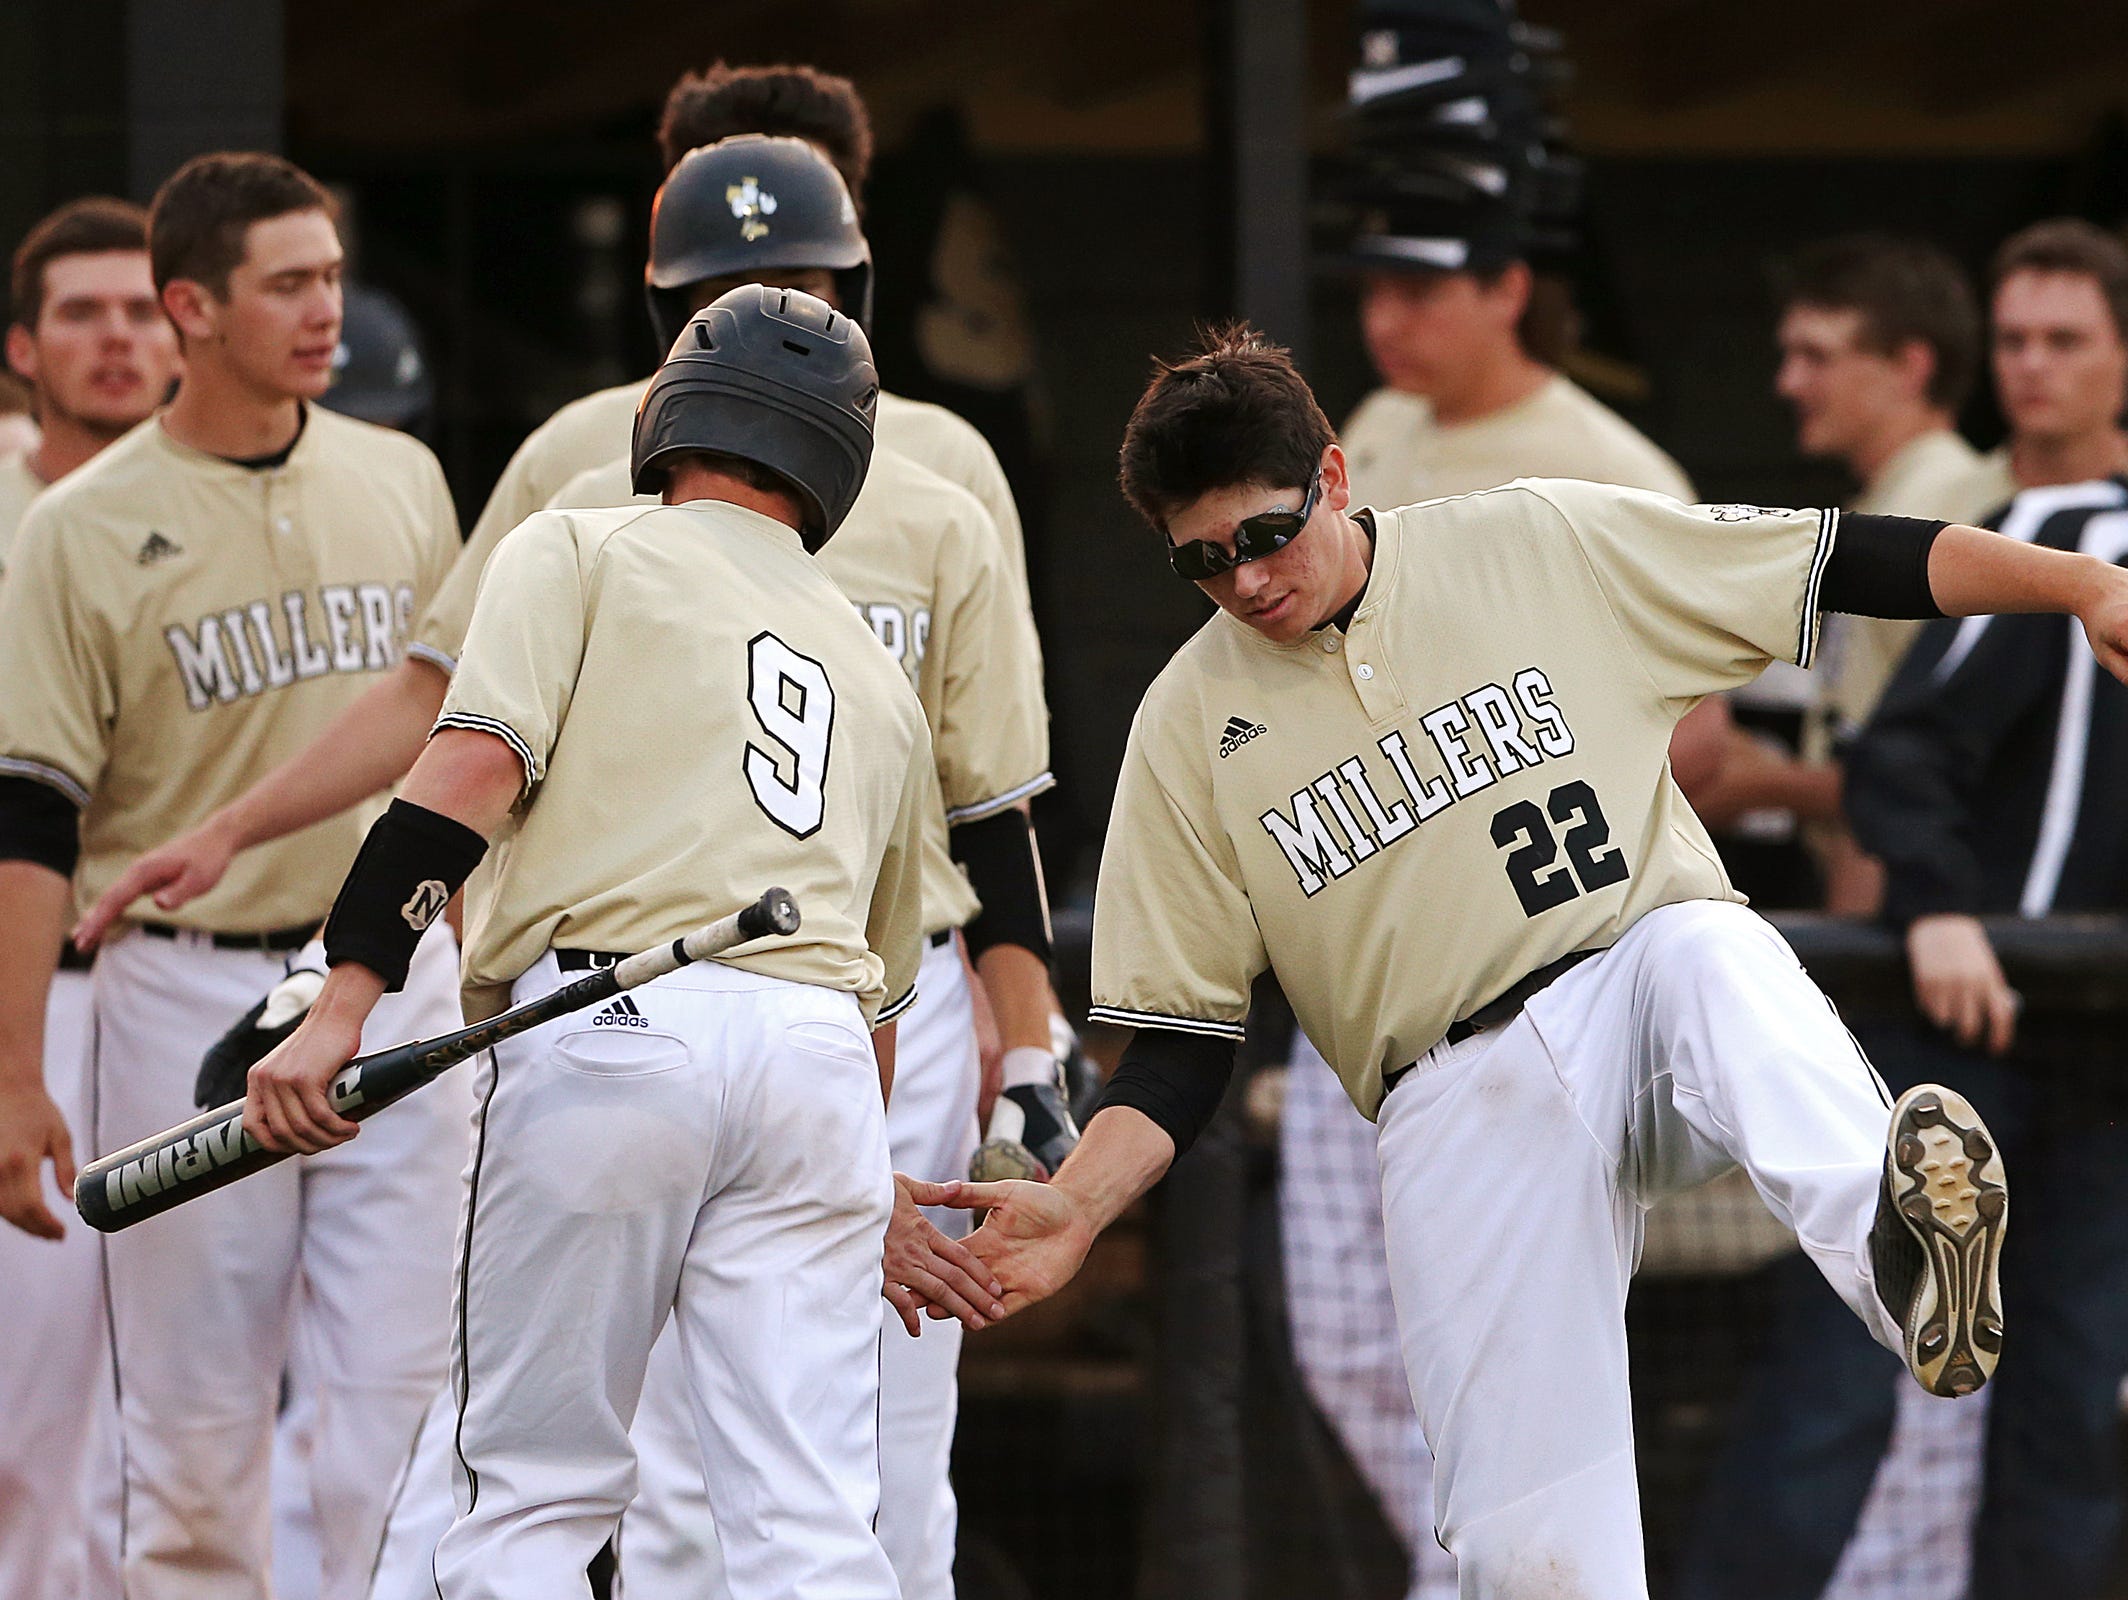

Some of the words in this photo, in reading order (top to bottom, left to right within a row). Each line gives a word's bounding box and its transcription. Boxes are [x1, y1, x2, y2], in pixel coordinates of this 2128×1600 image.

[742, 630, 835, 841] 9
[1218, 722, 1268, 760] adidas
[1258, 666, 1575, 899] MILLERS
[1490, 779, 1630, 918] 22
[592, 1012, 649, 1028] adidas
